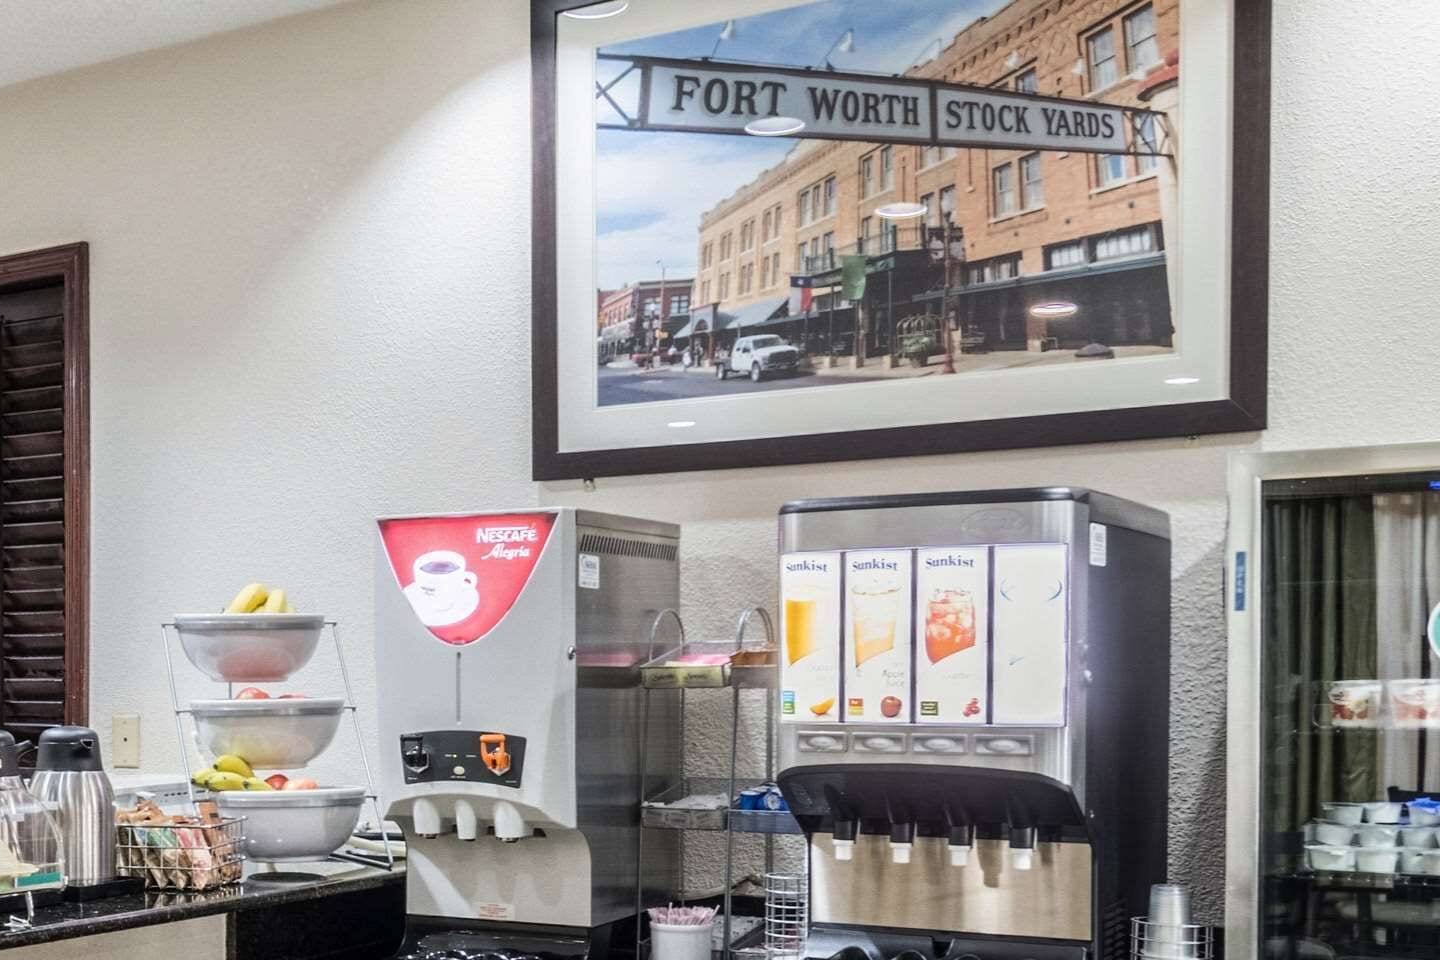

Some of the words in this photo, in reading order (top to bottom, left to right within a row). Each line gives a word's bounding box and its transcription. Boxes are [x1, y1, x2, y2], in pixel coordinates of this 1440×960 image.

[671, 75, 787, 117] FORT
[807, 86, 921, 127] WORTH
[945, 99, 1031, 135] STOCK
[1040, 107, 1116, 140] YARDS
[480, 543, 530, 560] Alegria
[785, 559, 829, 574] Sunkist
[851, 558, 898, 573] Sunkist
[925, 555, 976, 570] Sunkist
